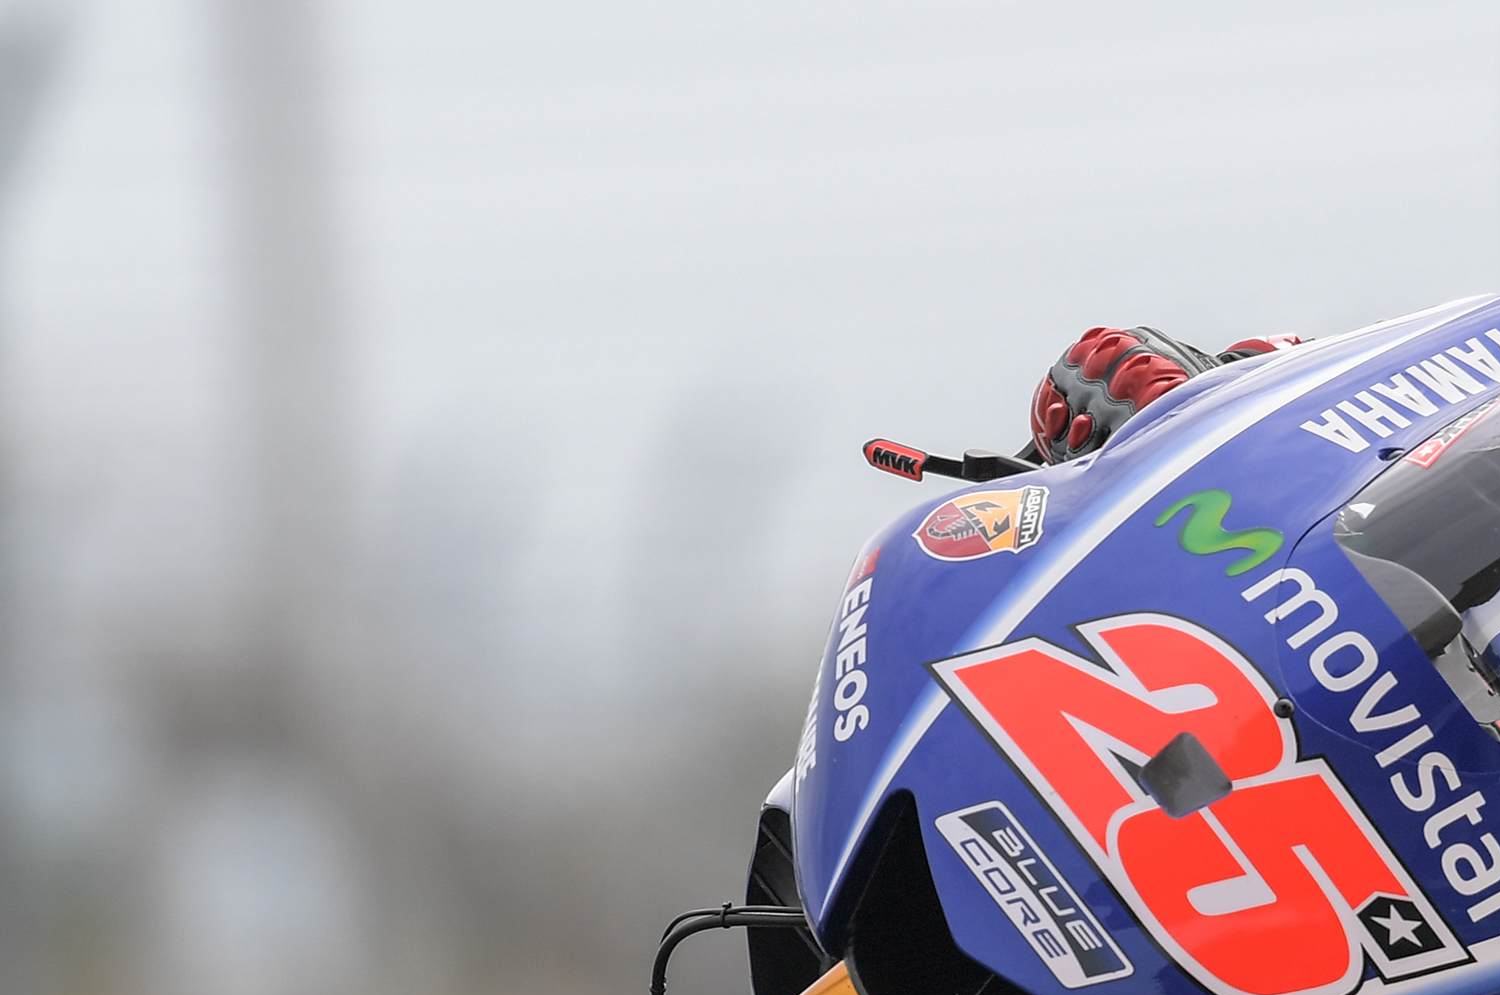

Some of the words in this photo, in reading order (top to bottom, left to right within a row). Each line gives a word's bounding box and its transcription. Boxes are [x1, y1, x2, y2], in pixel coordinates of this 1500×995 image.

[871, 445, 919, 476] MVK
[1019, 488, 1043, 544] ABARTH
[833, 577, 874, 742] ENEOS
[959, 838, 1067, 960] CORE
[992, 826, 1103, 953] BLUE
